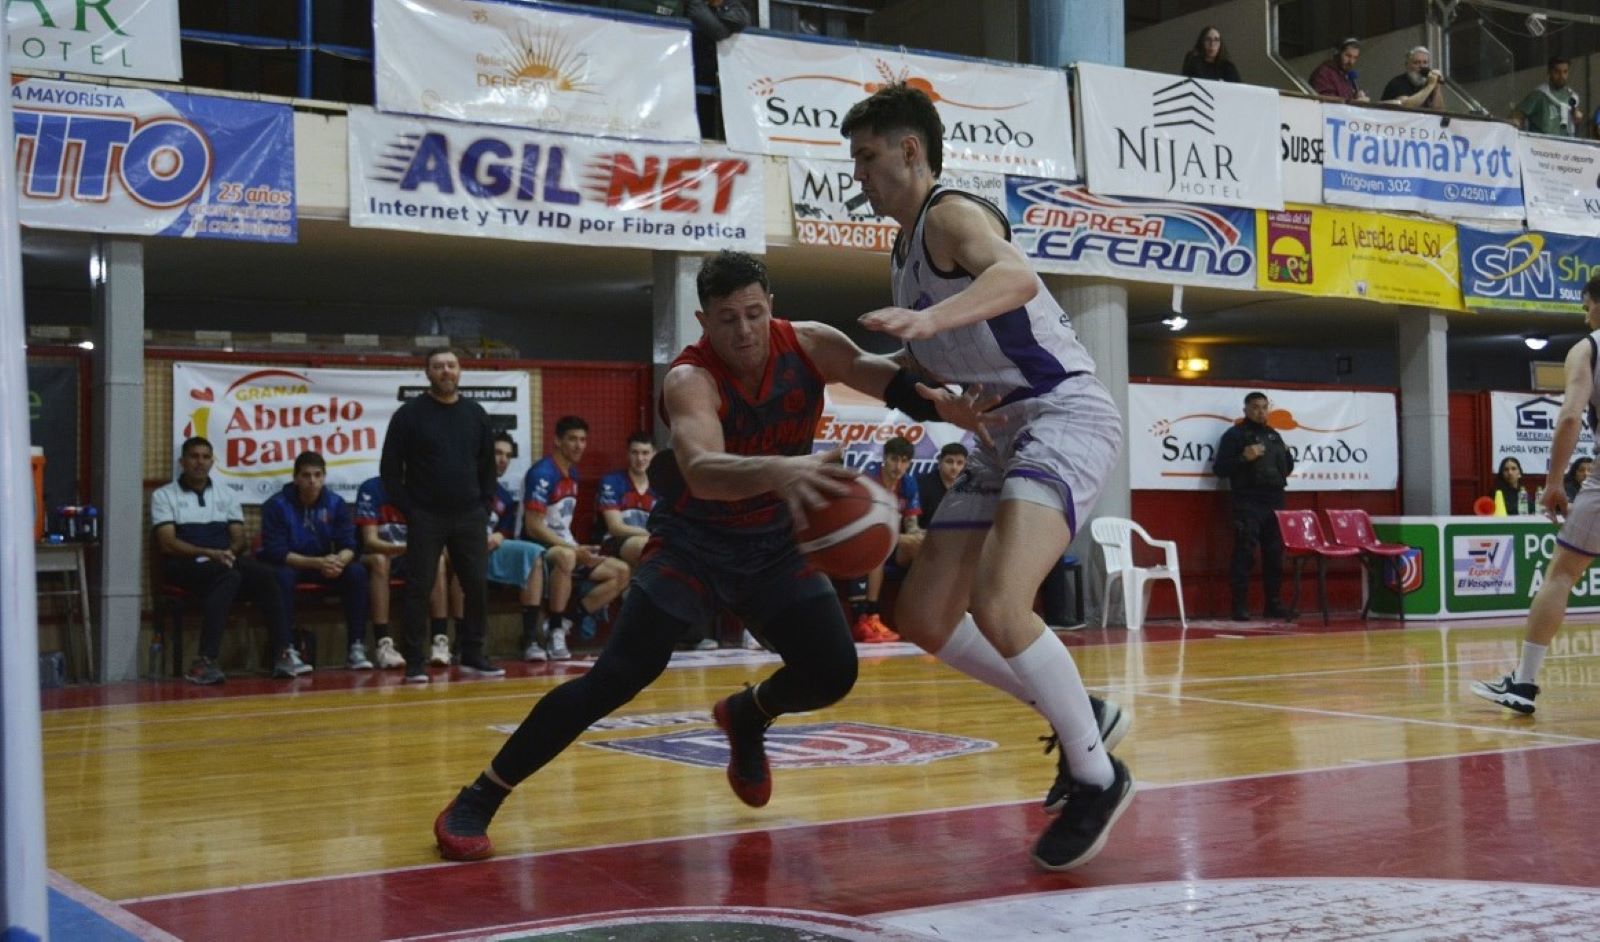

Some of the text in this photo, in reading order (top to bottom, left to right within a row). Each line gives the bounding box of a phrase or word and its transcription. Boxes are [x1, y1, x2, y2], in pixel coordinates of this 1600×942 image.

[8, 35, 132, 67] OTEL
[27, 88, 125, 108] MAYORISTA
[1326, 117, 1513, 178] TraumaProt
[1348, 121, 1449, 142] ORTOPEDIA
[400, 132, 748, 214] AGIL NET
[973, 177, 1001, 189] Suelo
[1340, 172, 1496, 201] Yrigoyen 302 425014
[218, 183, 291, 205] 25 años
[1181, 182, 1240, 199] HOTEL
[370, 198, 746, 240] Internet y TV HD por Fibra óptica
[1026, 204, 1165, 238] EMPRESA
[1331, 220, 1441, 258] La Vereda del Sol
[1472, 245, 1554, 298] SN
[235, 386, 309, 401] GRANJA
[225, 397, 363, 434] Abuelo
[815, 415, 925, 448] Expreso
[226, 426, 377, 468] Ramón
[1500, 445, 1549, 454] AHORA VENT
[1516, 431, 1552, 439] MATERIAL
